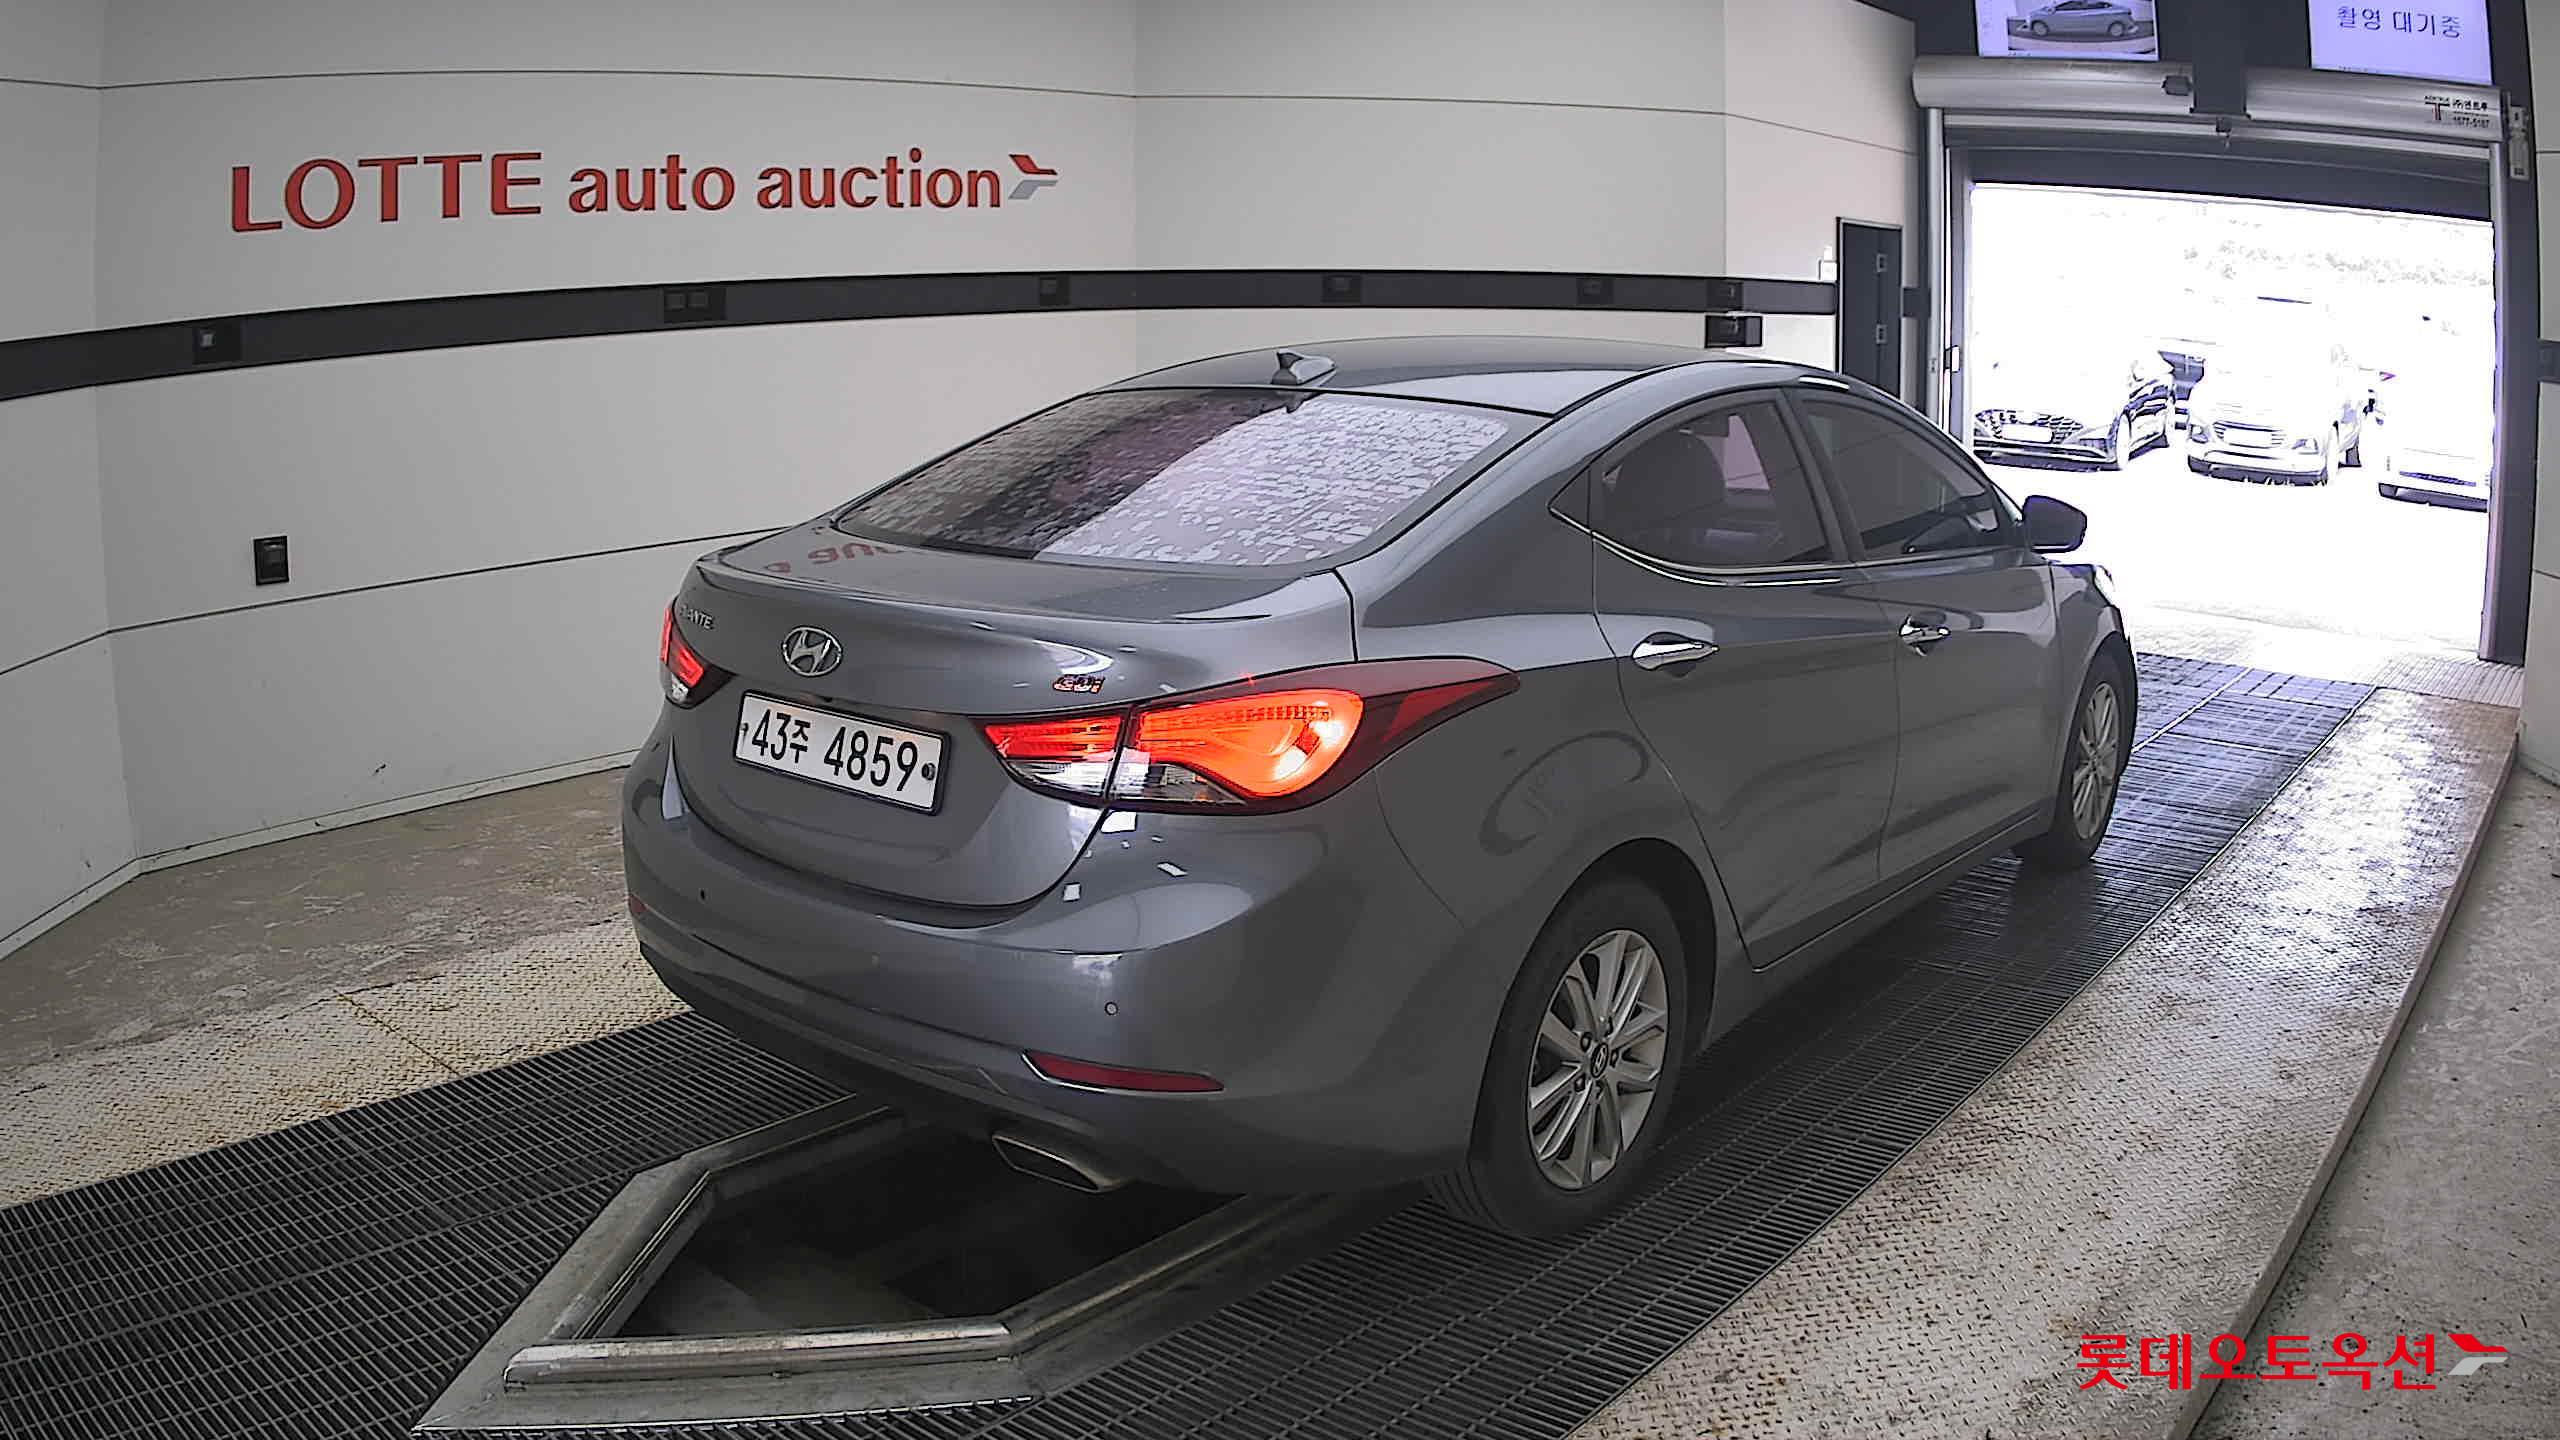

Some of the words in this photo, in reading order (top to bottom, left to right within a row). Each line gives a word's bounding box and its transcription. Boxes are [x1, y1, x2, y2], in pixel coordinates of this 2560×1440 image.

[2337, 6, 2381, 31] 촬영
[232, 152, 541, 232] LOTTE
[568, 154, 736, 213] auto
[756, 147, 1001, 210] auction
[750, 707, 811, 764] 43주
[823, 726, 919, 793] 4859
